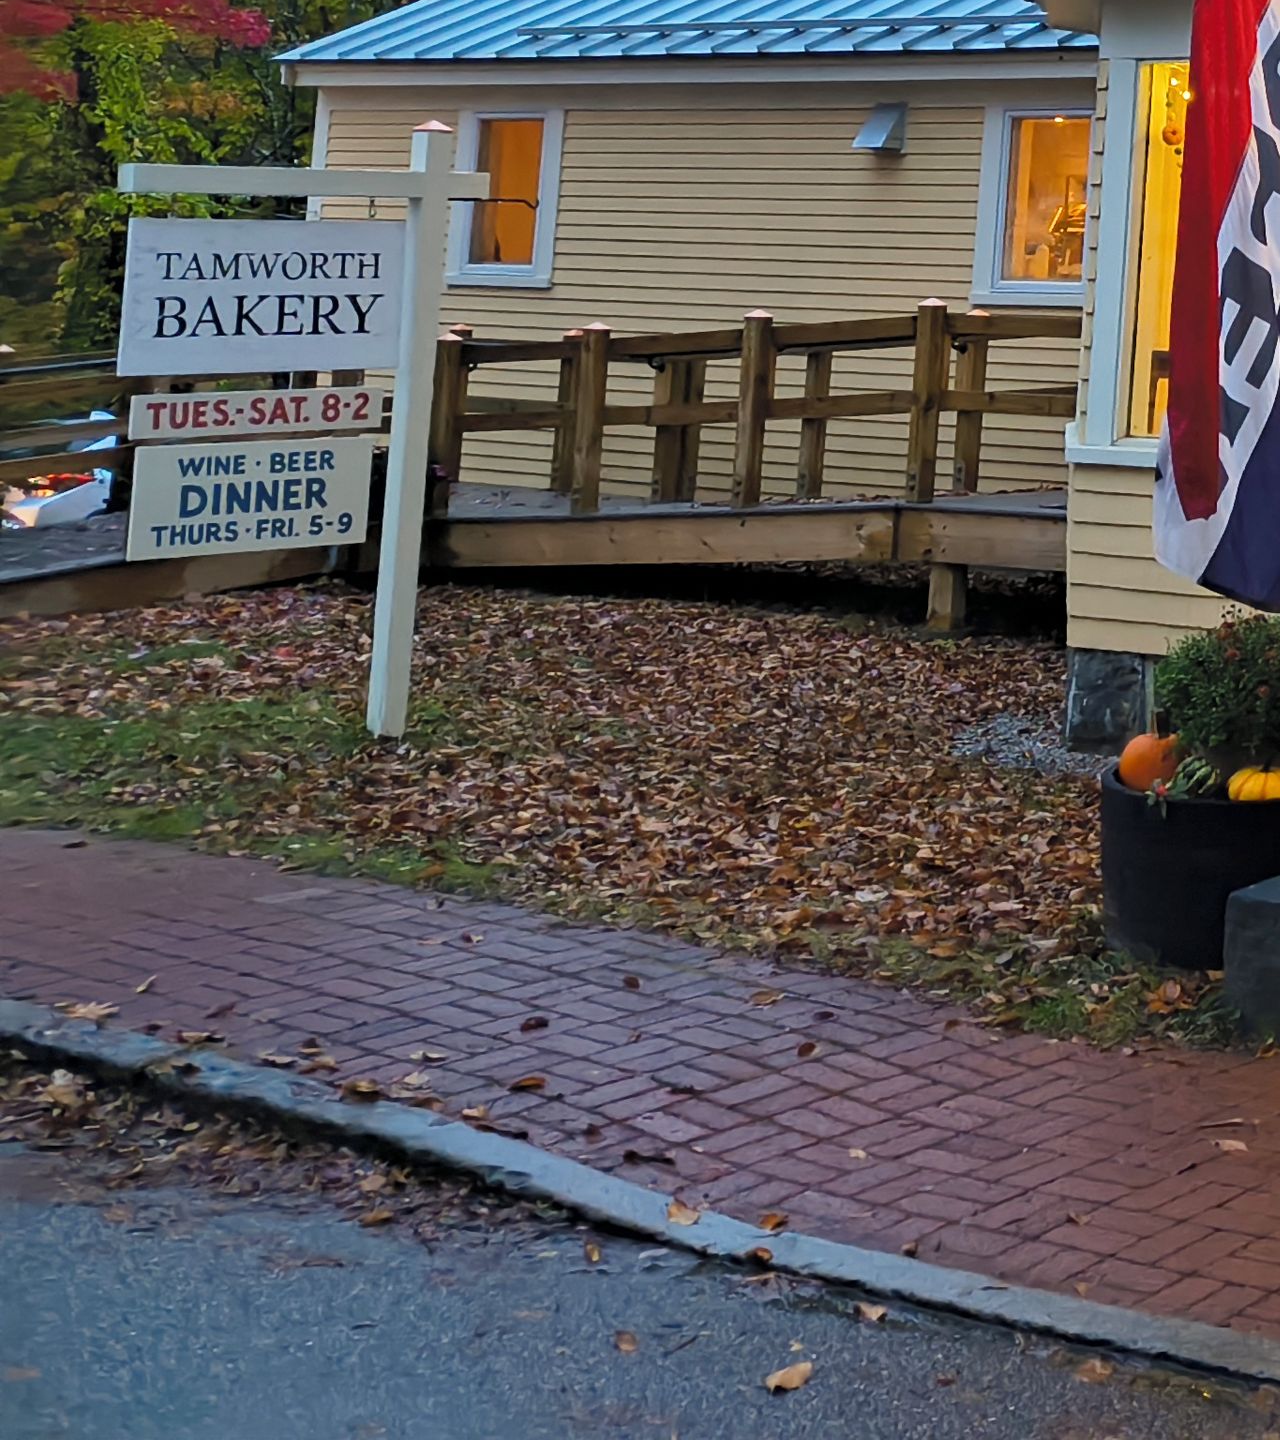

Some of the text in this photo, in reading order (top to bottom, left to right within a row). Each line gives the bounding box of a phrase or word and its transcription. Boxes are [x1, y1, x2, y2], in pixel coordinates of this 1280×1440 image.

[156, 251, 382, 281] TAMWORTH
[152, 293, 385, 340] BAKERY
[320, 392, 370, 423] 8-2
[177, 449, 336, 478] WINE BEER
[178, 477, 329, 519] DINNER
[308, 512, 353, 536] 5-9
